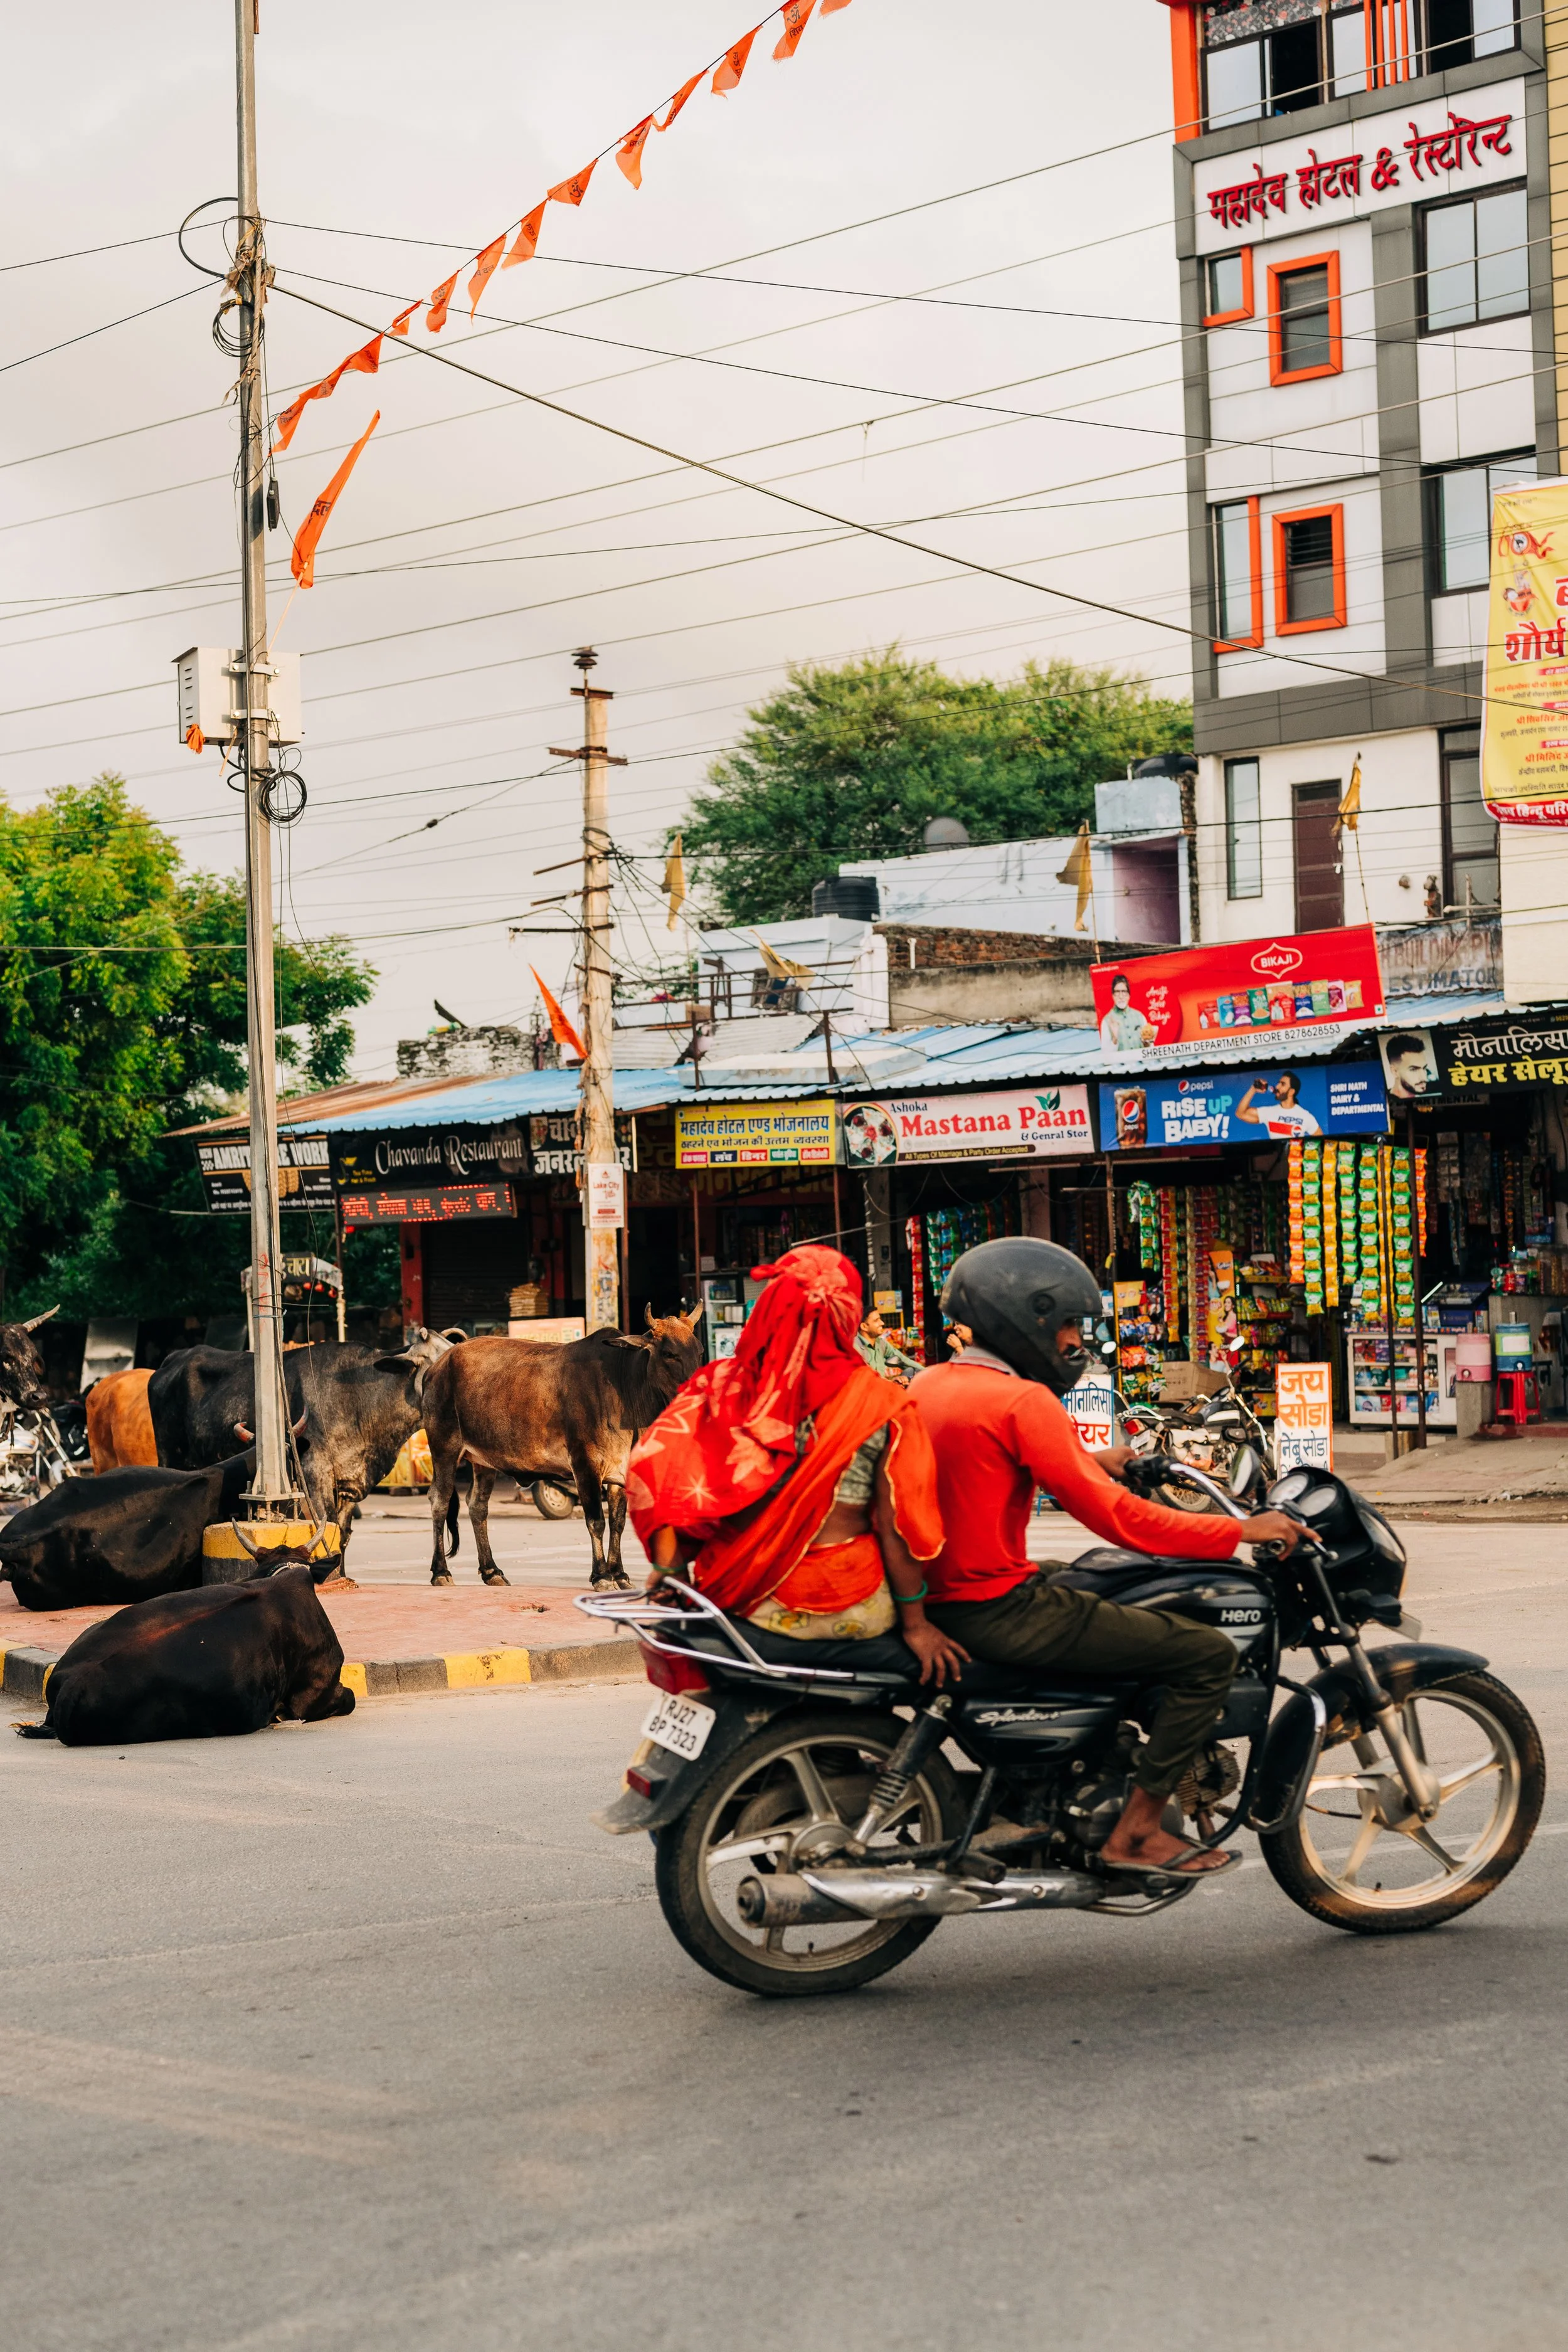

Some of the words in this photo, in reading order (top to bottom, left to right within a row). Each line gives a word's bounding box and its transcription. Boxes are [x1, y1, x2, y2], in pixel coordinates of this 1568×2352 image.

[1207, 163, 1288, 229] महादेव
[1296, 148, 1363, 210] होटल
[1371, 147, 1399, 191] &
[1261, 953, 1293, 968] BIKAJI
[1142, 1044, 1191, 1058] SHREENATH
[1194, 1036, 1251, 1052] DEPARTMENT
[1254, 1031, 1282, 1044] STORE
[1285, 1024, 1340, 1040] 8278628553
[1450, 1025, 1568, 1059] मोनालिसा
[1448, 1061, 1508, 1086] हेयर
[1190, 1079, 1214, 1092] pepsi
[1330, 1083, 1347, 1093] SHRI
[1348, 1081, 1367, 1091] NATH
[889, 1101, 928, 1113] Ashoka
[1162, 1098, 1207, 1119] RISE
[1331, 1094, 1352, 1104] DAIRY
[1353, 1093, 1360, 1103] &
[1278, 1115, 1303, 1125] PEPSI
[1332, 1103, 1385, 1116] DEPARTMENTAL
[681, 1116, 714, 1136] महादेव
[717, 1115, 745, 1135] होटल
[748, 1118, 770, 1133] एण्ड
[774, 1113, 830, 1131] भोजनालय
[901, 1115, 1011, 1138] Mastana
[1018, 1106, 1087, 1129] Paan
[1164, 1113, 1230, 1143] BABY!
[681, 1138, 704, 1148] ठहरने
[751, 1135, 763, 1145] की
[765, 1137, 790, 1145] उत्तम
[793, 1136, 829, 1145] व्यवस्था
[1021, 1133, 1029, 1141] &
[1031, 1130, 1064, 1141] Genral
[1067, 1130, 1088, 1138] Stor
[289, 1141, 330, 1165] WORK
[444, 1135, 523, 1175] Restaurant
[714, 1152, 733, 1162] लंच
[741, 1150, 766, 1161] डिनर
[913, 1151, 930, 1160] Types
[938, 1150, 963, 1159] Marriage
[969, 1148, 984, 1157] Party
[985, 1147, 1001, 1155] Order
[1002, 1145, 1029, 1154] Accepted
[286, 1257, 310, 1277] चाय
[1281, 1371, 1324, 1393] जय
[1279, 1394, 1328, 1428] सोडा
[1303, 1430, 1328, 1457] सोडा
[1221, 1609, 1261, 1624] Hero
[665, 1699, 697, 1727] RJ27
[649, 1715, 667, 1735] BP
[665, 1724, 697, 1752] 7323
